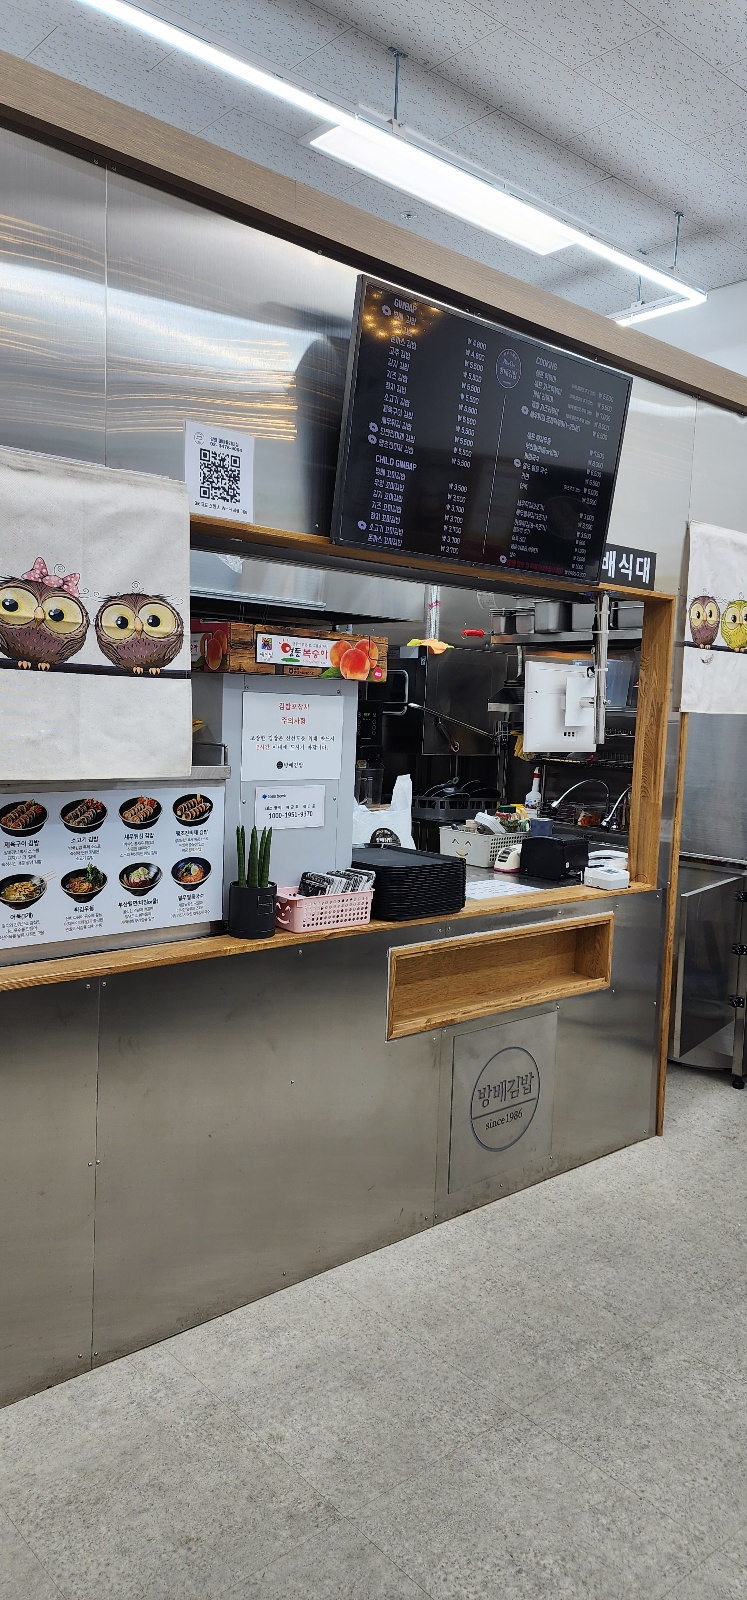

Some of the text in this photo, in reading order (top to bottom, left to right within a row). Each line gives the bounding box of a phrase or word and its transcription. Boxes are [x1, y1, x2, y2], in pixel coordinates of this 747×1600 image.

[375, 454, 394, 466] CHILD
[602, 550, 650, 584] 배식대
[303, 648, 328, 660] 복숭아
[279, 703, 310, 711] 김밥포장시
[281, 716, 306, 725] 주의사항
[478, 1071, 535, 1108] 방배김밥
